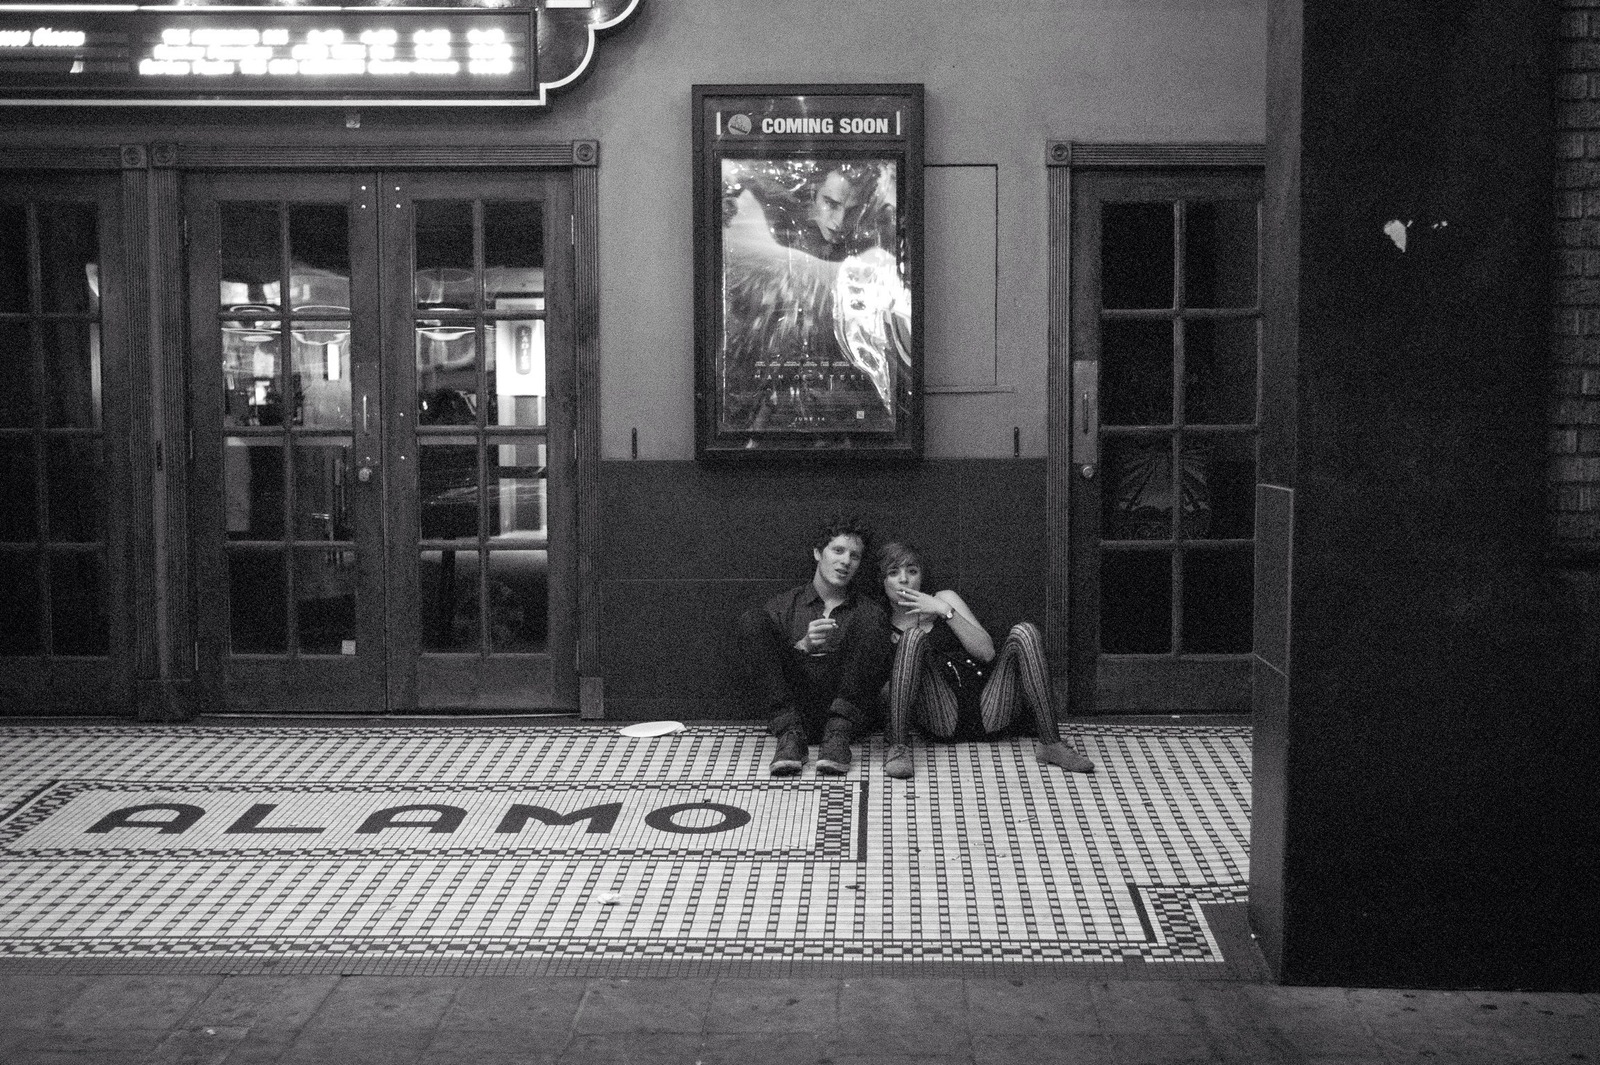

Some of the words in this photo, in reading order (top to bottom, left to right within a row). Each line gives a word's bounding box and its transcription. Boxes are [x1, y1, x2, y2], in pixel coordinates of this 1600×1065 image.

[761, 117, 834, 134] COMING
[839, 117, 889, 134] SOON
[83, 802, 752, 835] ALAMO
